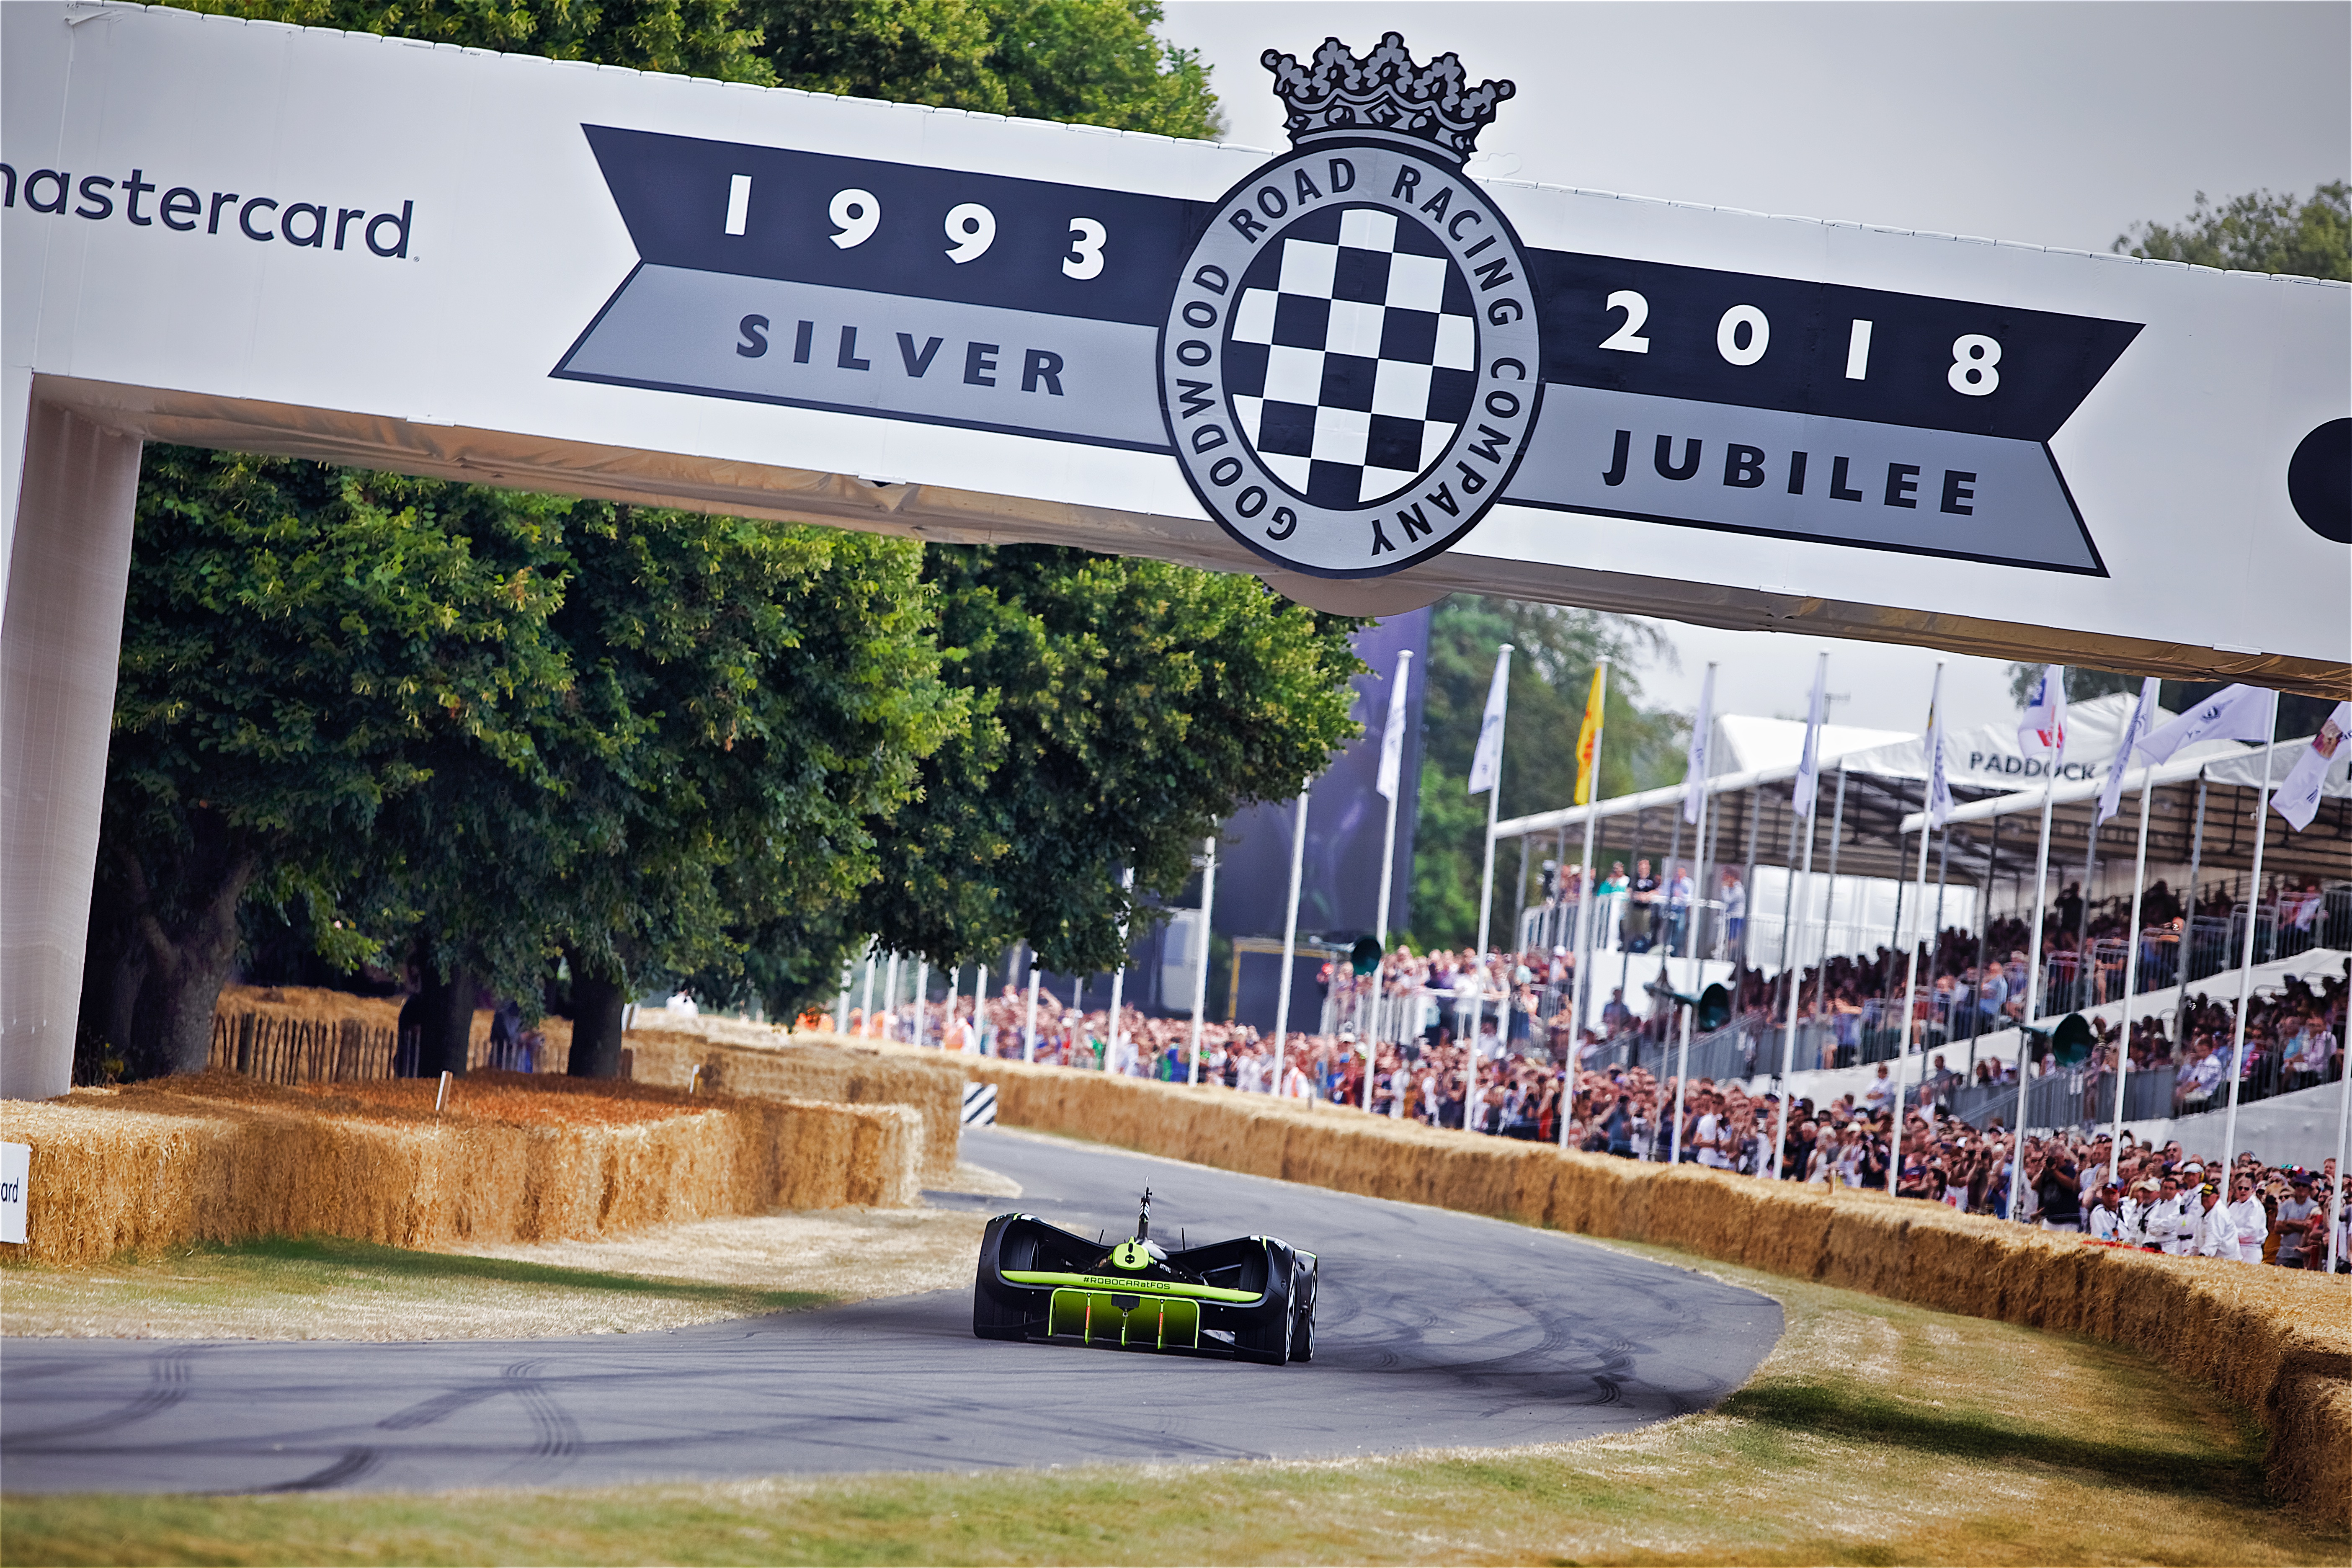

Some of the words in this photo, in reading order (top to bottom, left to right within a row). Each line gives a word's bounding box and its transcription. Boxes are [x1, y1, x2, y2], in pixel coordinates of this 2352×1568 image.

[724, 173, 1107, 280] 1993
[1228, 157, 1356, 244] ROAD
[1390, 164, 1524, 327] RACING
[736, 314, 1064, 396] SILVER
[1599, 290, 2003, 396] 2018
[1176, 264, 1297, 542] GOODWOOD
[1370, 356, 1525, 557] COMPANY
[1602, 429, 1977, 516] JUBILEE
[0, 1176, 19, 1203] ard
[1083, 1277, 1171, 1290] #ROBOCARatFOS
